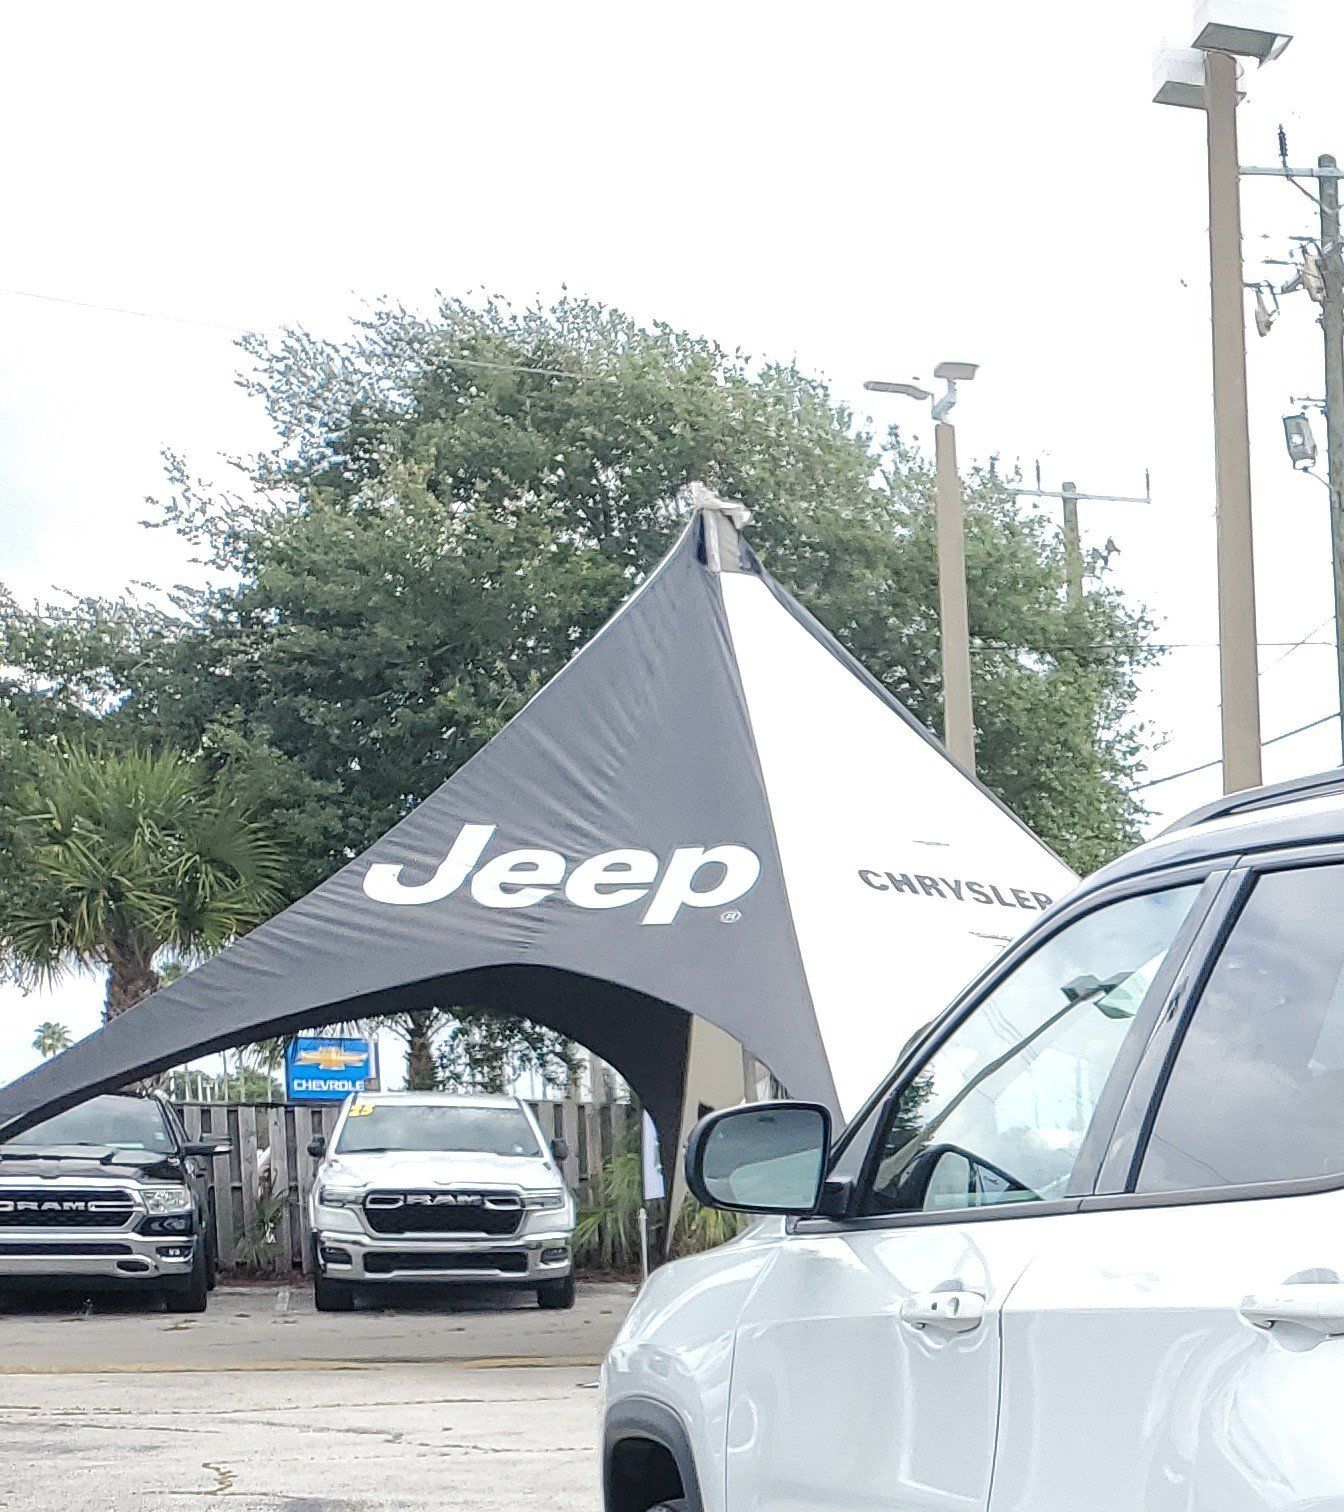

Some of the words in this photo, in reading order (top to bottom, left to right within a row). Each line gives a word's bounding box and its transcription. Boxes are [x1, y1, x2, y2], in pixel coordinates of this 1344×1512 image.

[363, 824, 760, 925] Jeep
[293, 1079, 364, 1091] CHEVROLE
[17, 1200, 85, 1211] RAM
[405, 1195, 483, 1206] RAM
